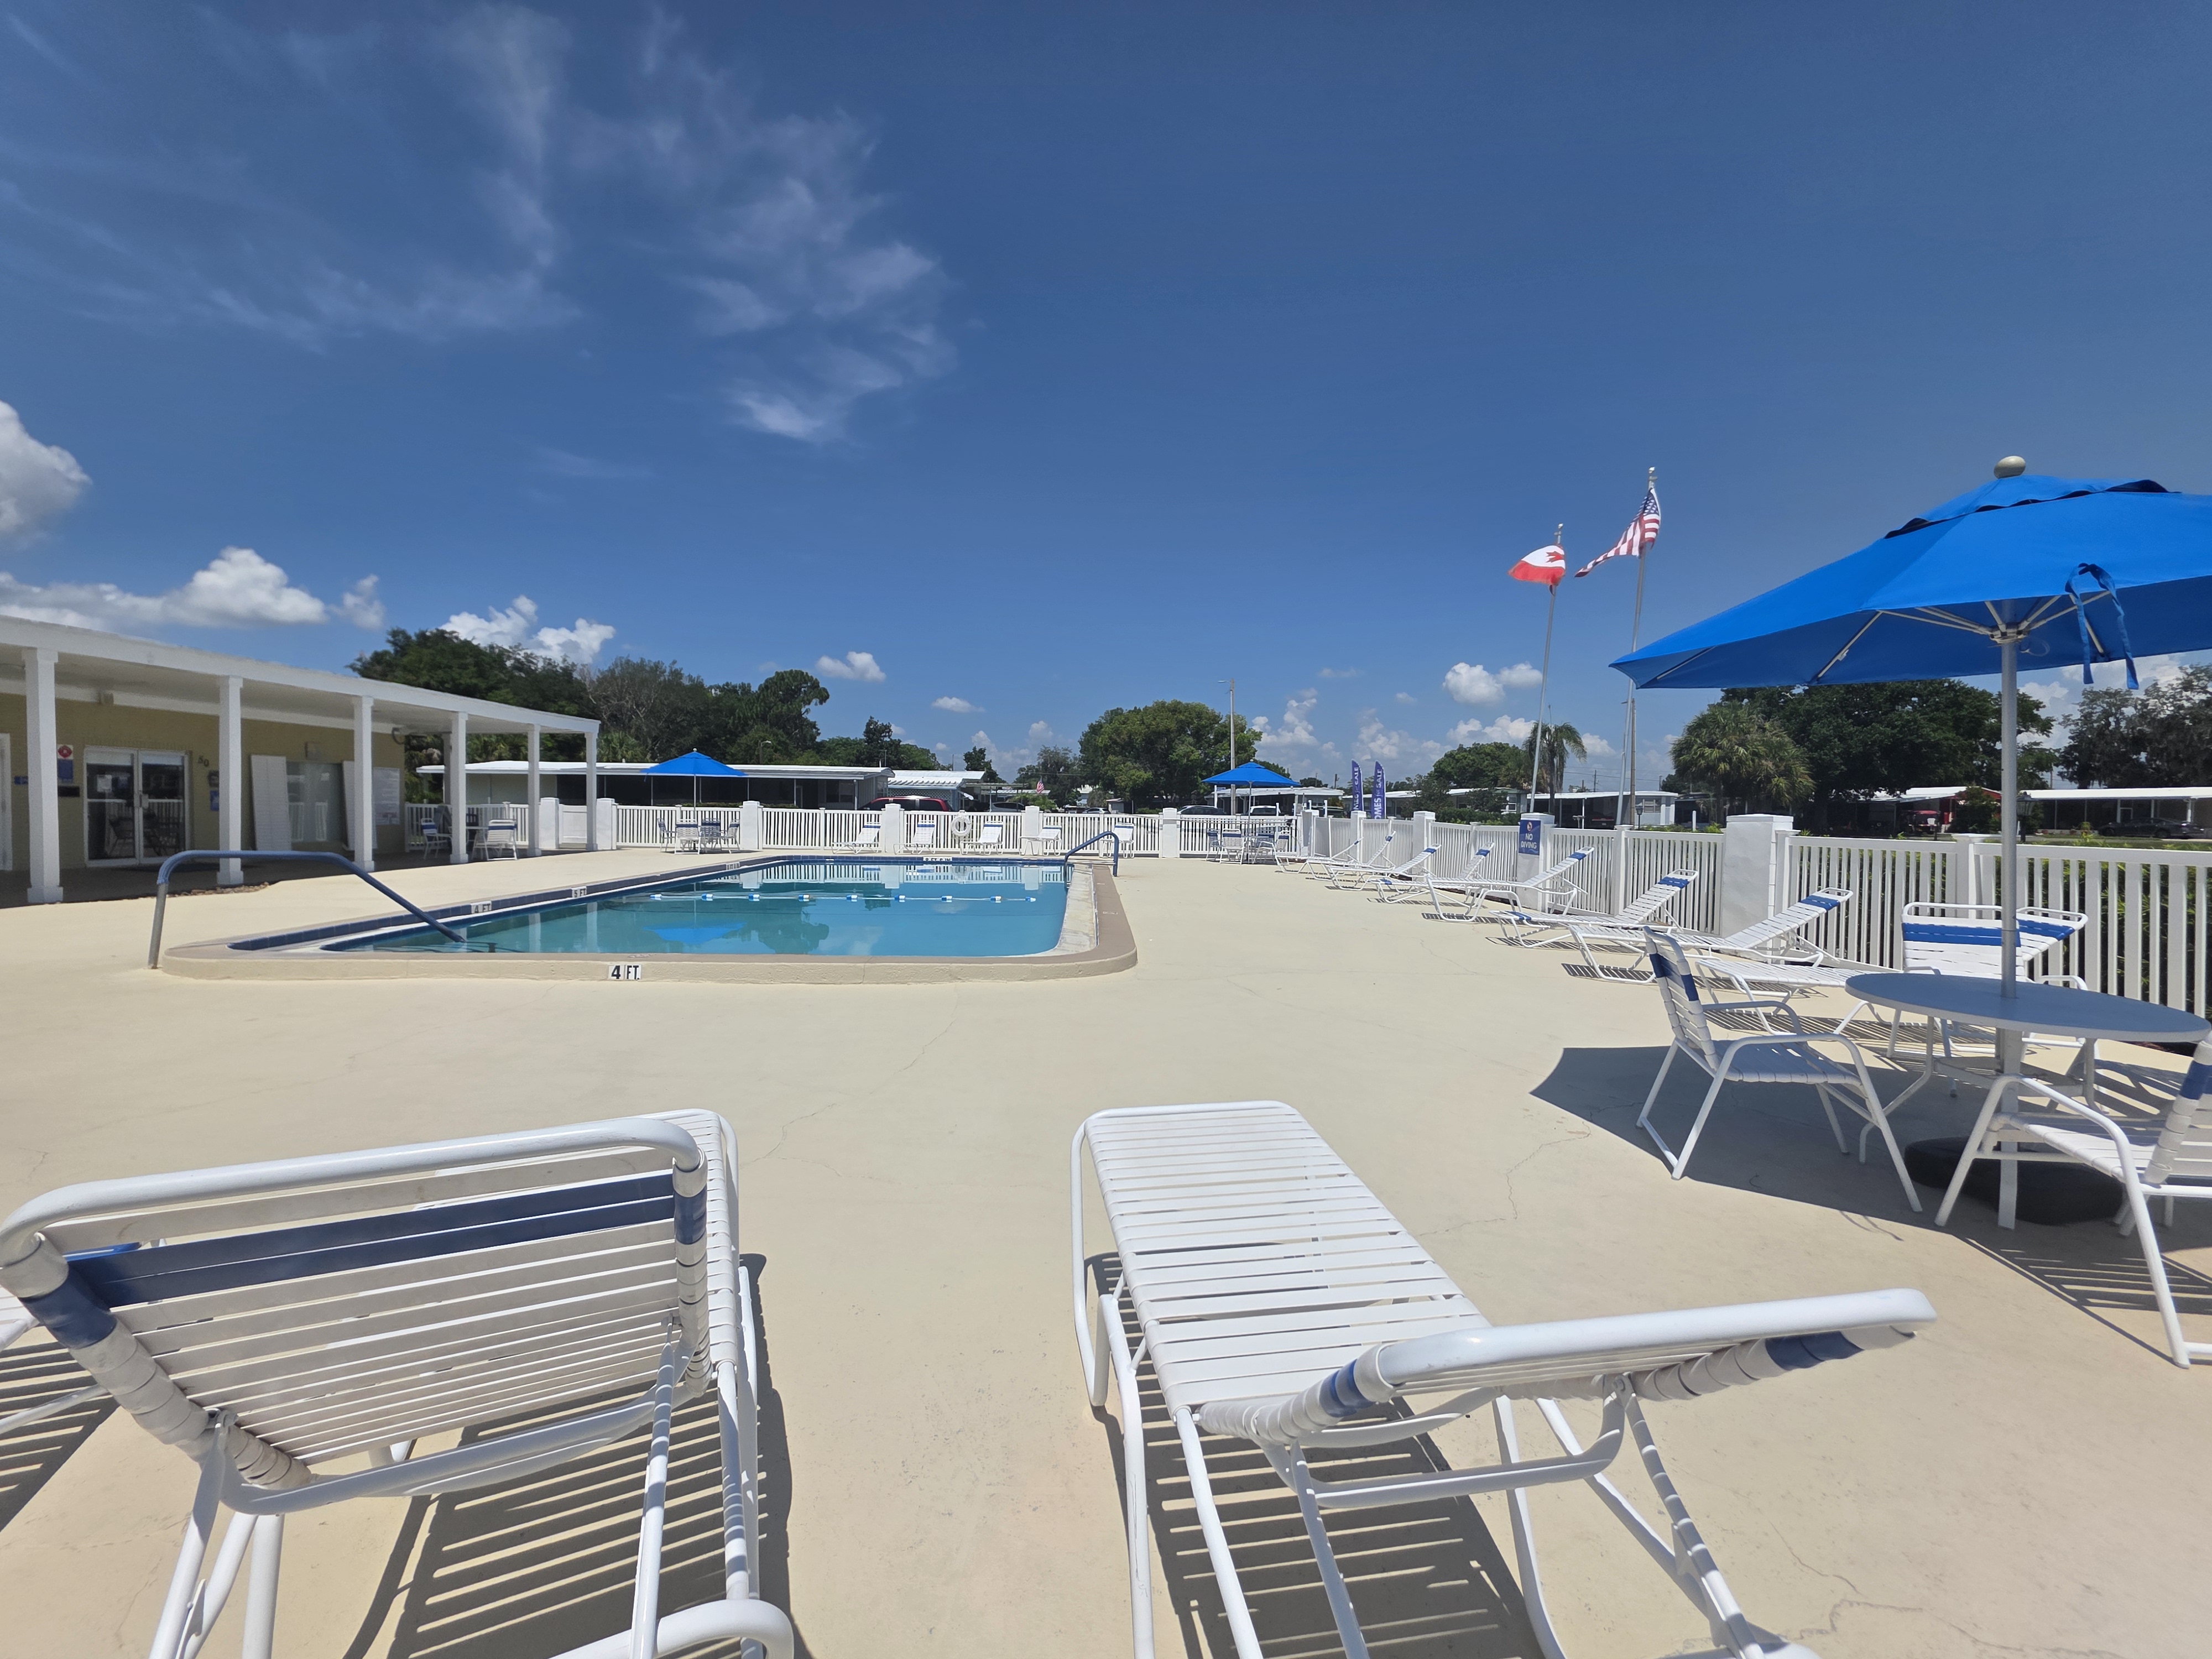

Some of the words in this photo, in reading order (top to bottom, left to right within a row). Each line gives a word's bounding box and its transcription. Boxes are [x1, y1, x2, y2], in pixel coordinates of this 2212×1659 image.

[1374, 798, 1382, 820] OMES
[611, 965, 621, 979] 4
[627, 965, 640, 980] FT.
